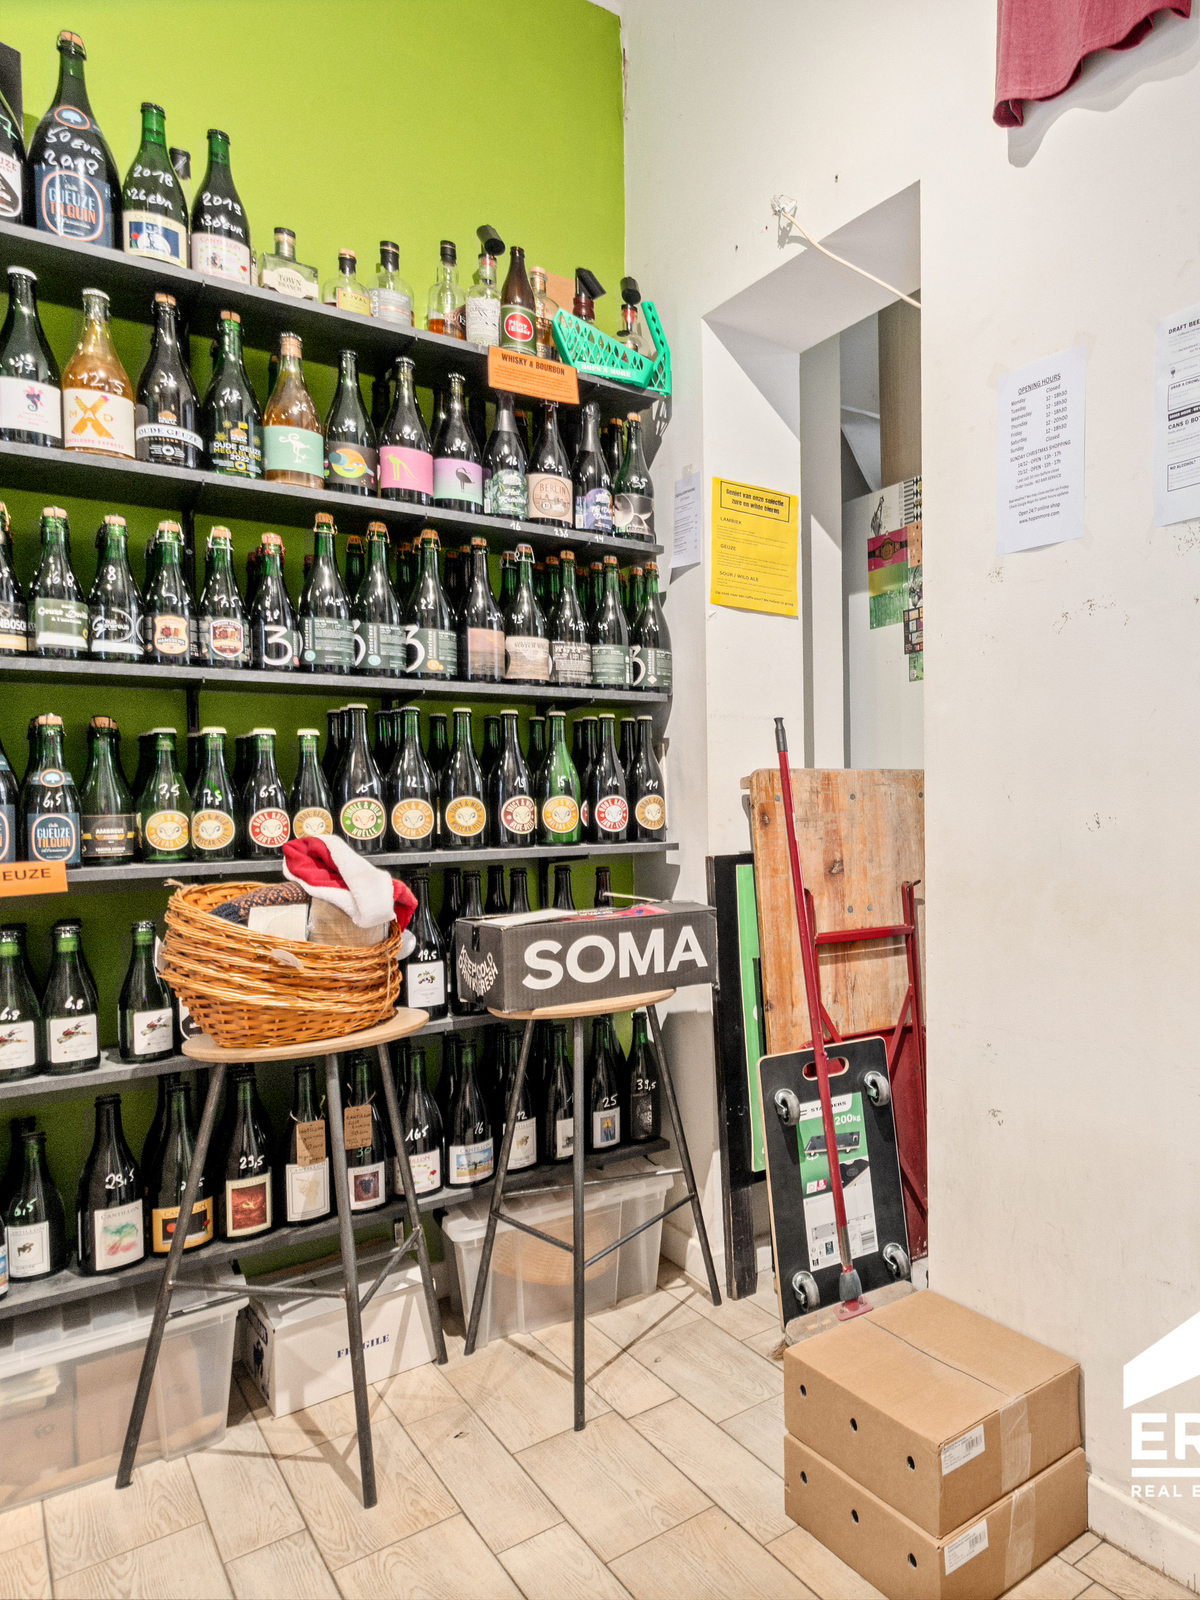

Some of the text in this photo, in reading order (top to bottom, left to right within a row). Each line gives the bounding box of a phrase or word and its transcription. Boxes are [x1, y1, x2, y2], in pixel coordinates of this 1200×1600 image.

[45, 126, 71, 143] 50
[44, 149, 99, 176] 2018
[133, 165, 173, 187] 2018
[50, 201, 96, 225] TLQUIN
[278, 274, 302, 287] TOWN
[343, 292, 367, 304] KOVAL
[1168, 323, 1187, 335] DRAFT
[501, 353, 527, 367] WHISKY
[535, 362, 565, 376] BOURBON
[580, 363, 632, 378] HOPS N MORE
[1018, 373, 1061, 395] OPENING HOURS
[1011, 384, 1060, 406] Monday Closed
[1168, 421, 1183, 430] CANS
[138, 428, 199, 443] OUDE GEUZE
[213, 441, 261, 456] OUDE GEUZE
[1011, 433, 1060, 454] Sunday Closed
[213, 447, 261, 461] MEGABLEND
[1010, 439, 1071, 463] SUNDAY CHRISTMAS SHOPPING
[230, 454, 249, 463] 2022
[539, 483, 567, 496] BERLIN
[726, 488, 742, 498] Geniet
[742, 492, 751, 500] van
[752, 494, 764, 502] onze
[750, 502, 763, 511] wilde
[510, 521, 521, 530] 16
[720, 516, 742, 525] LAMBIEK
[720, 543, 736, 551] GEUZE
[263, 625, 293, 665] 3
[557, 775, 567, 787] 15
[260, 785, 277, 798] 6,5
[43, 791, 63, 808] 6,5
[506, 800, 520, 813] JUICY
[599, 799, 627, 812] OUDE KRIEK
[369, 802, 382, 817] WILD
[395, 803, 411, 817] PALE
[420, 803, 431, 816] WILD
[450, 802, 463, 814] JUICY
[470, 801, 483, 813] WILD
[194, 814, 208, 828] JUICY
[214, 814, 229, 826] WILD
[252, 812, 288, 827] OUDE KRIEK
[297, 811, 330, 823] OUDE GEUZE
[37, 828, 71, 839] GUEUZE
[351, 827, 377, 837] NOELLE
[37, 838, 71, 848] TILQUIN
[461, 944, 493, 979] KEEP COLD
[522, 925, 708, 990] SOMA
[602, 1094, 618, 1108] 25
[835, 1114, 861, 1126] 200kg
[459, 1143, 491, 1154] CANTILLON
[100, 1205, 140, 1220] CANTILLON
[337, 1334, 390, 1359] FGILE
